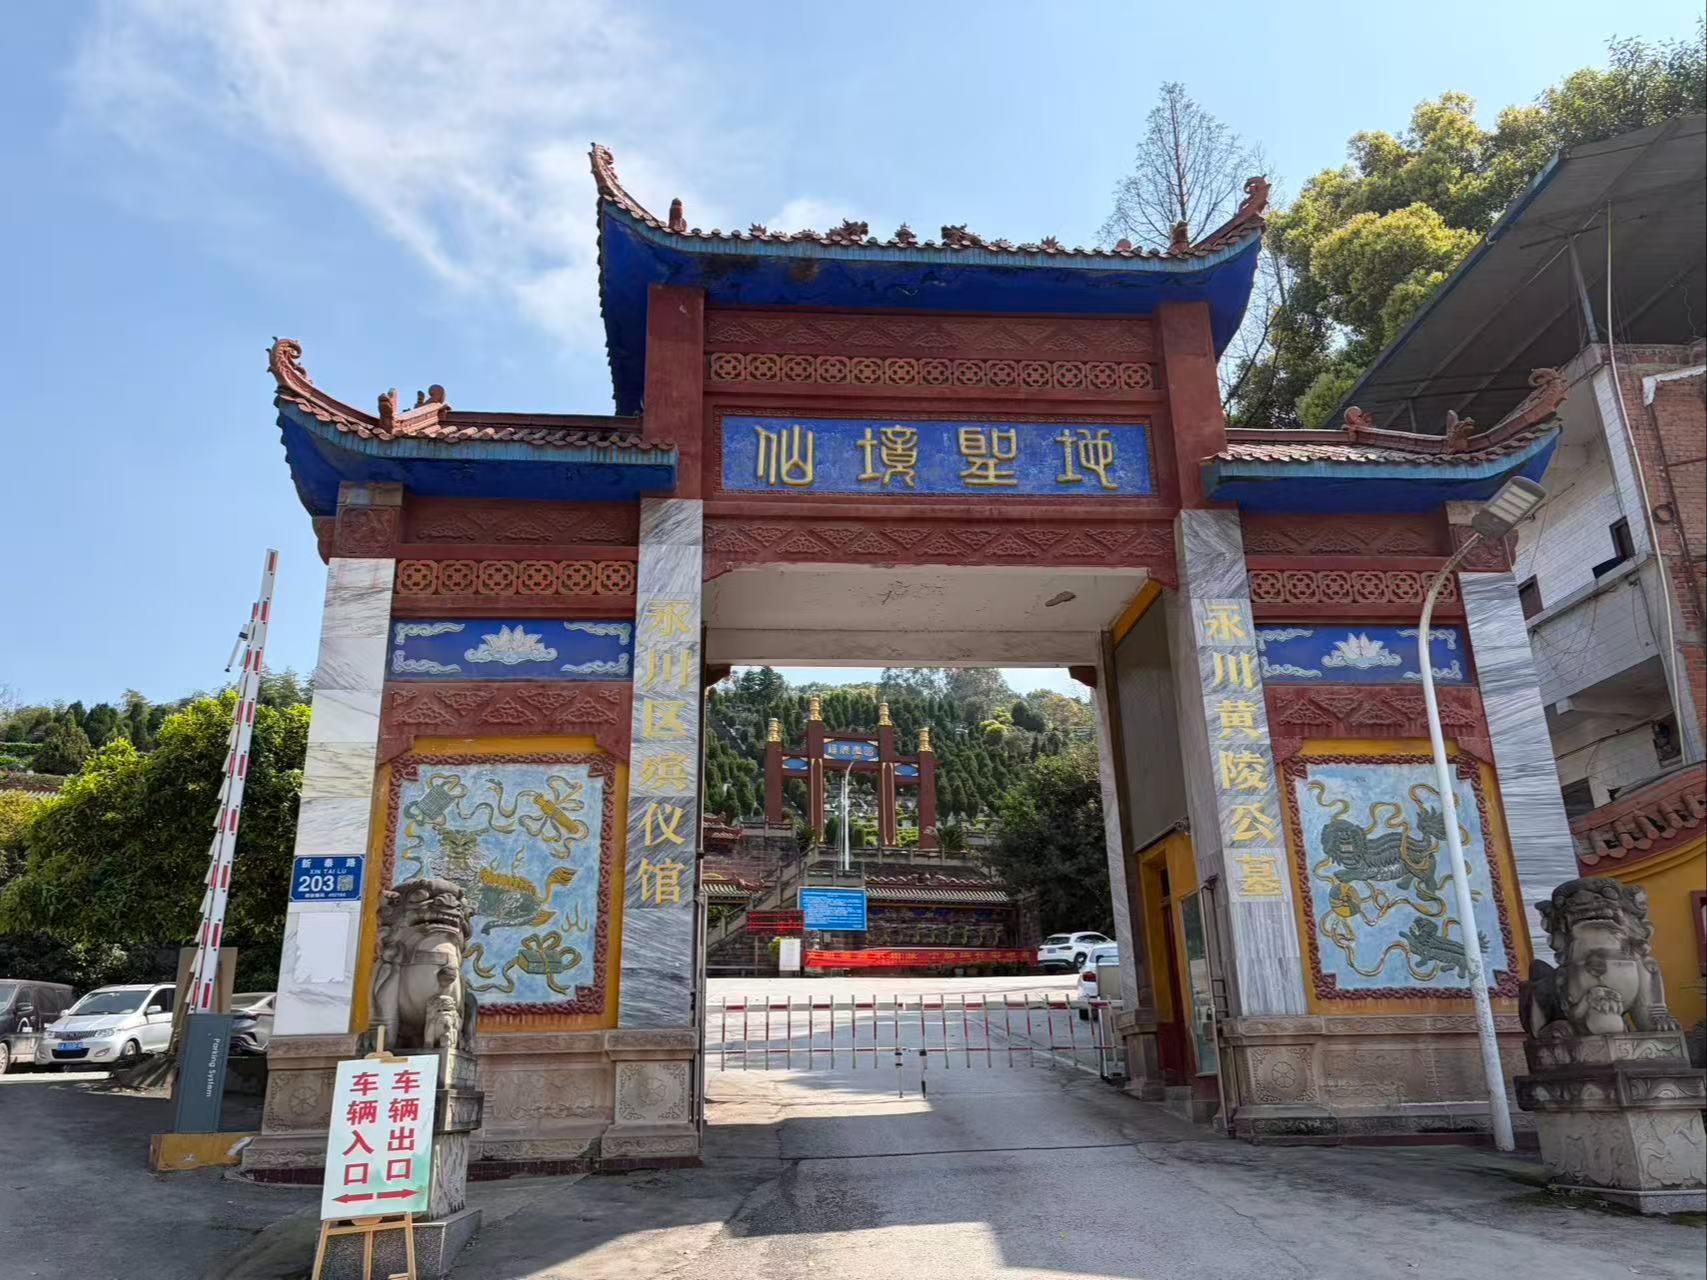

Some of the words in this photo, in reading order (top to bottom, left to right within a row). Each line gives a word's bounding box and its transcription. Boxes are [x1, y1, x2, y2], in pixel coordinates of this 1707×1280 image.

[639, 601, 694, 904] 永川区殡仪馆
[1204, 603, 1284, 898] 永川黄陵公墓
[298, 875, 334, 892] 203
[206, 1069, 216, 1097] System
[208, 1038, 221, 1067] Parking
[342, 1071, 379, 1186] 车辆入口
[386, 1069, 420, 1181] 车辆出口
